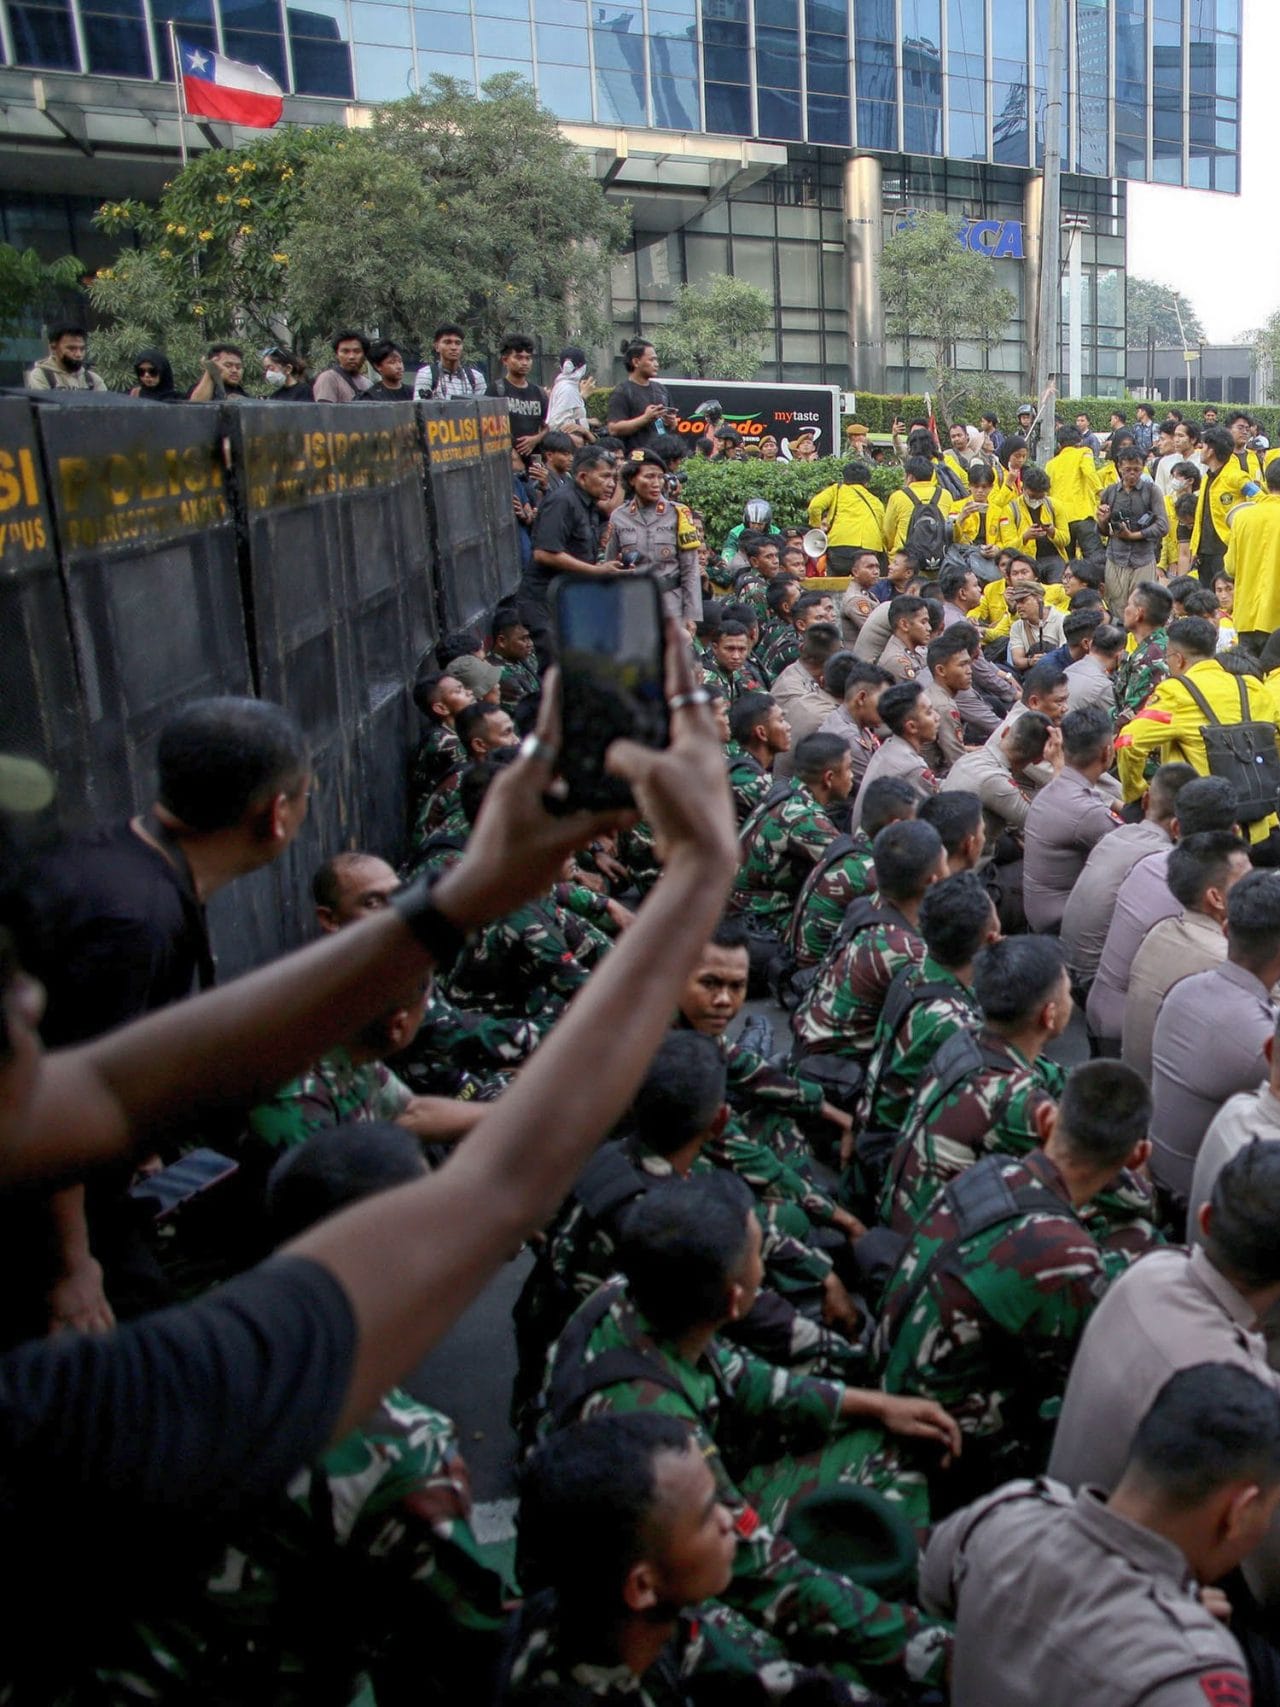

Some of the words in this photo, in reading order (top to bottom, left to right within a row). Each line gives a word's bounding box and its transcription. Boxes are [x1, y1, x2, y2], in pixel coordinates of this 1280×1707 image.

[775, 410, 819, 423] mytaste
[427, 418, 478, 445] POLISI
[481, 414, 511, 437] POLISI
